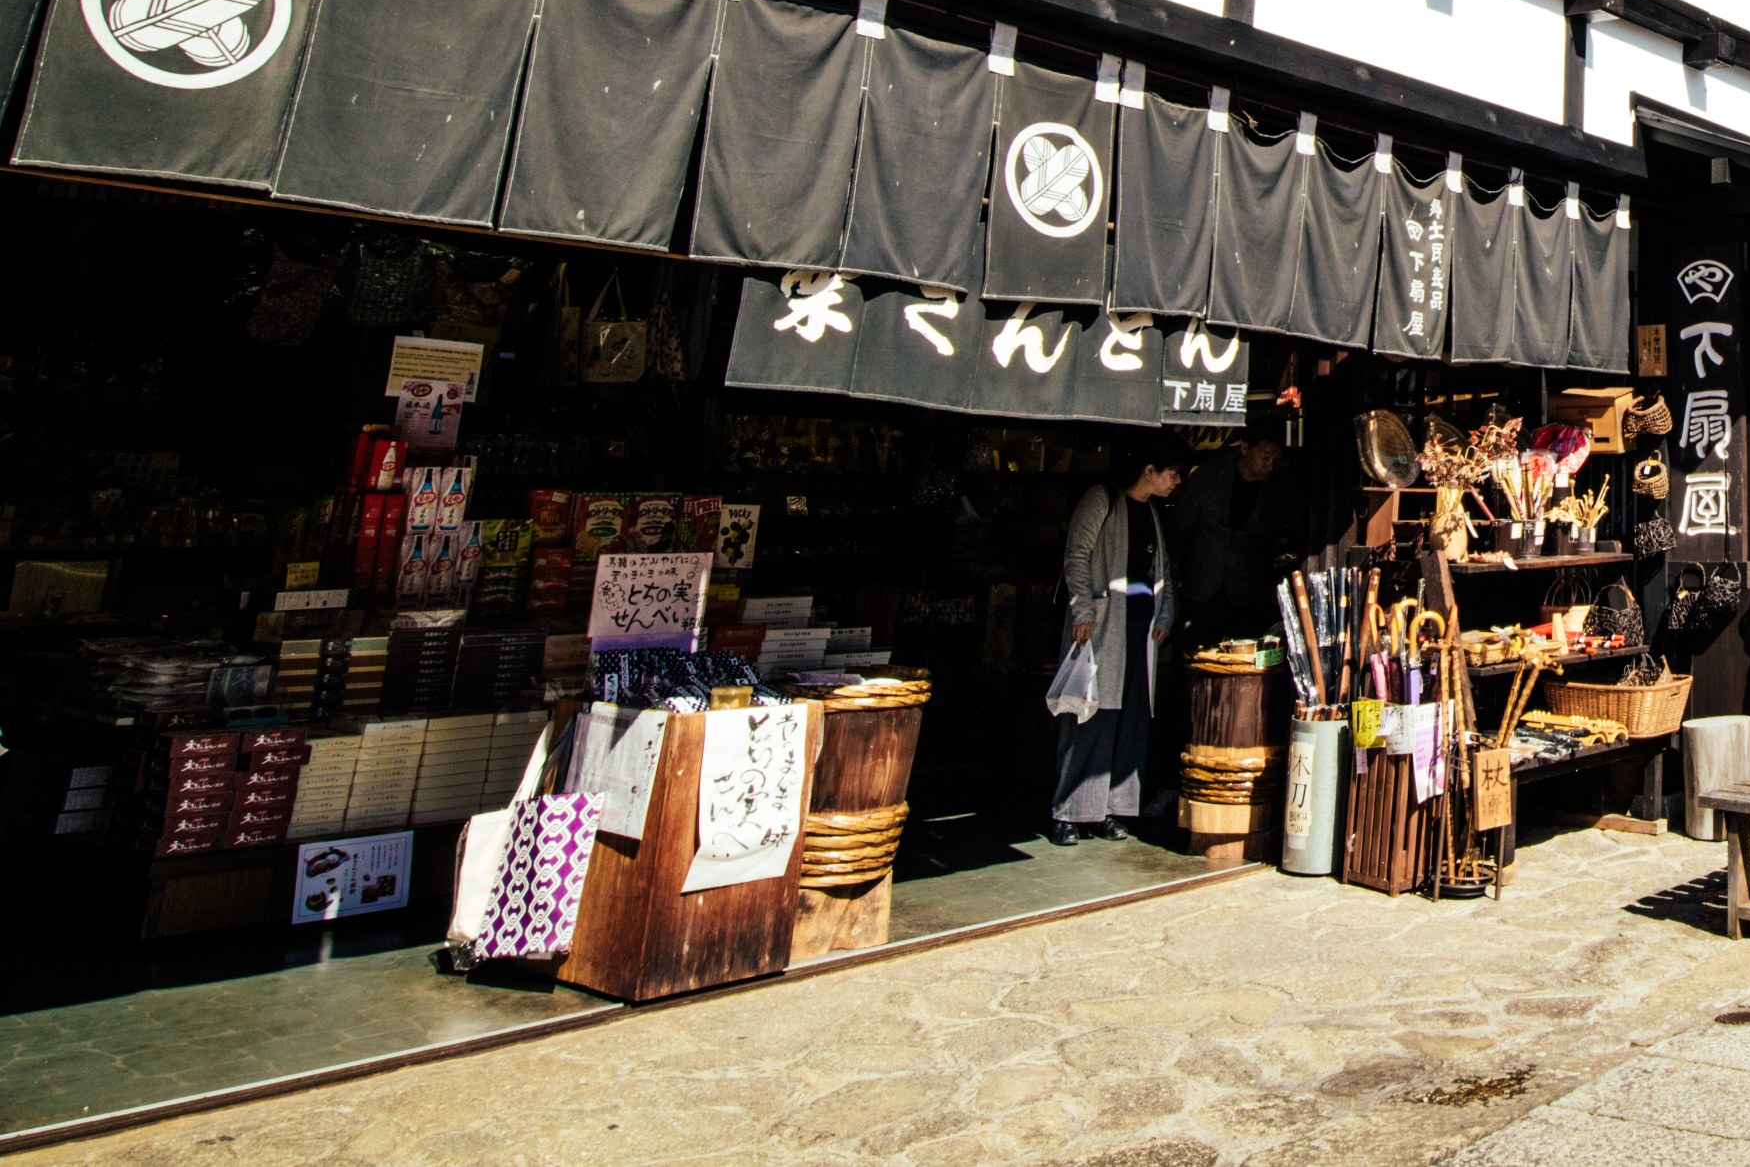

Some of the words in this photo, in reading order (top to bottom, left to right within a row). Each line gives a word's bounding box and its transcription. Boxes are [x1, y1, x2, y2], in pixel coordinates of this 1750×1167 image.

[1429, 198, 1444, 311] 郷土民芸品
[1403, 251, 1425, 336] 下扇屋
[1164, 379, 1248, 413] 下扇屋
[1679, 322, 1737, 536] 下扇屋
[611, 607, 689, 632] せんべい
[628, 579, 692, 606] とちの実
[737, 713, 773, 830] とちの実
[1291, 754, 1310, 808] 木刀
[1481, 758, 1508, 791] 杖
